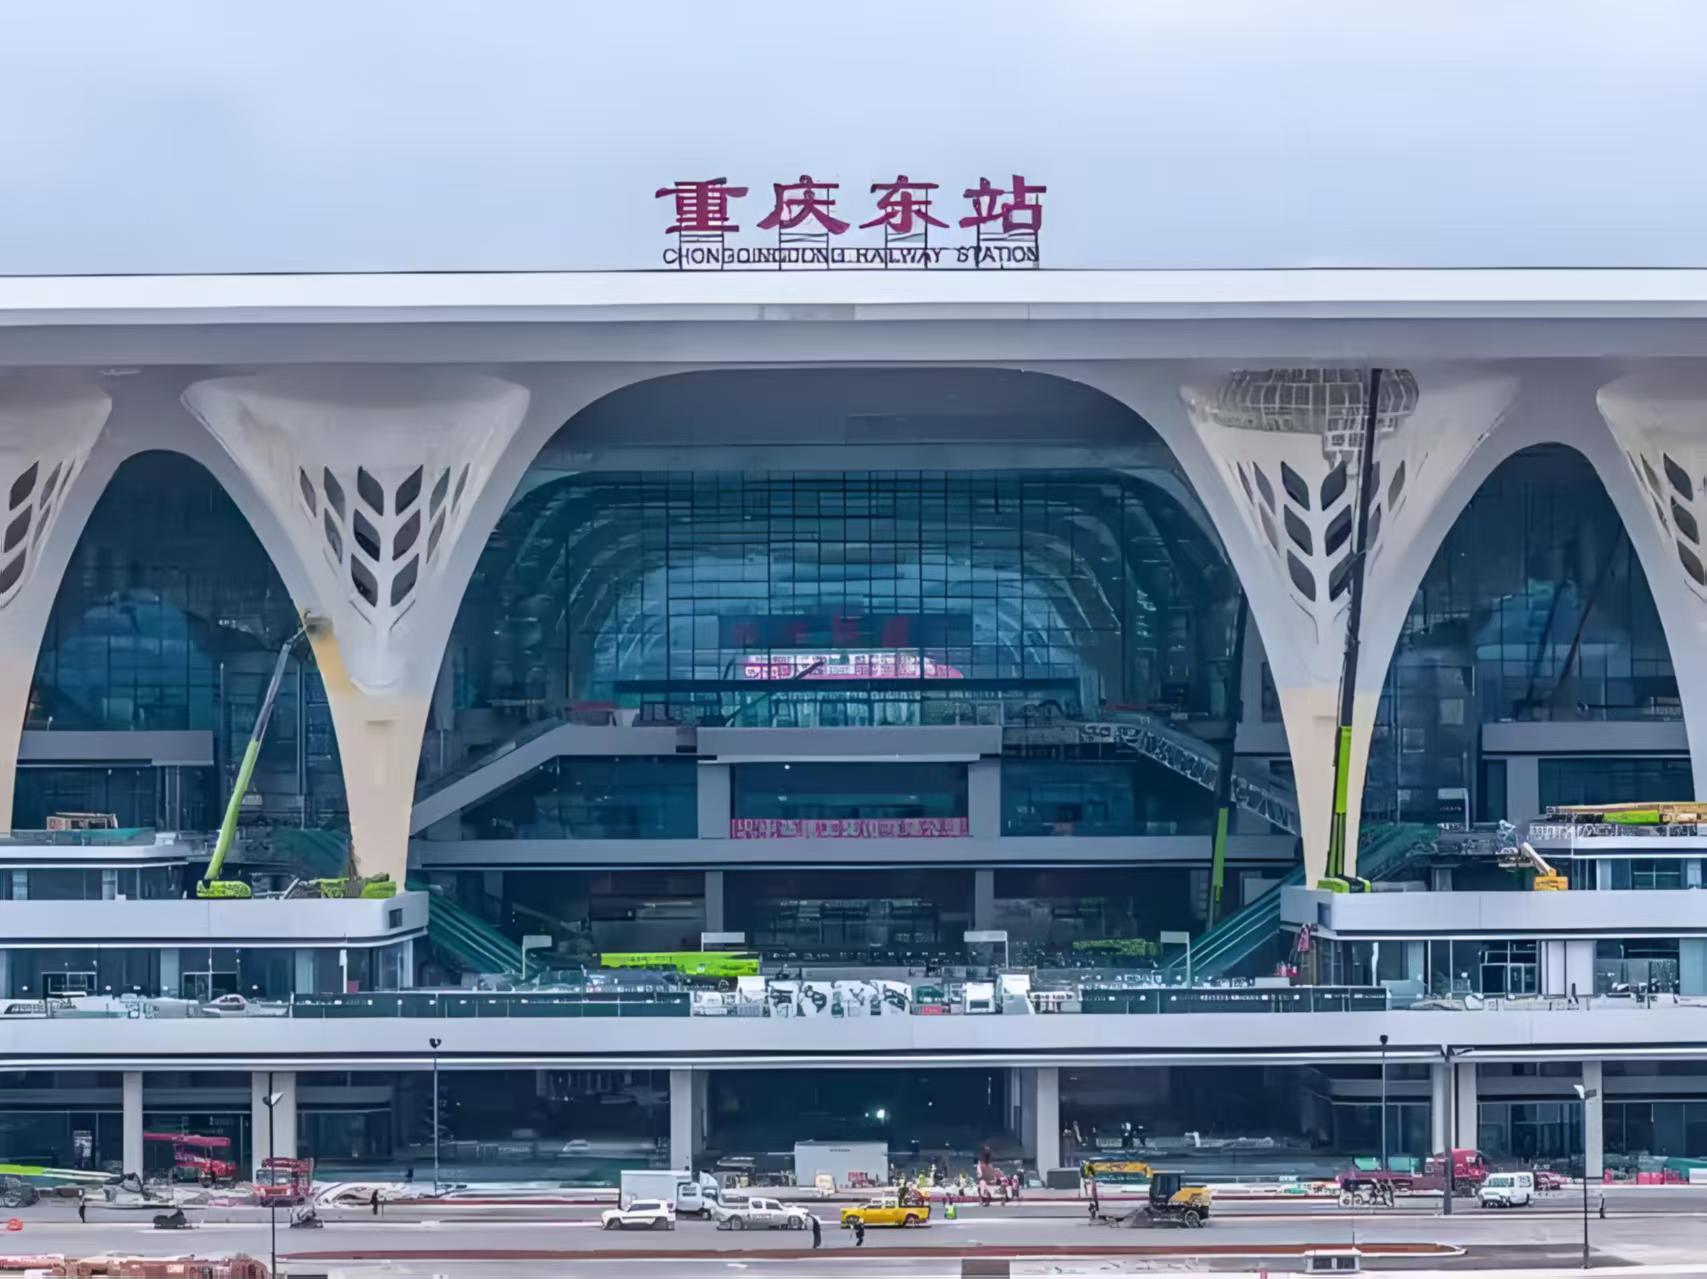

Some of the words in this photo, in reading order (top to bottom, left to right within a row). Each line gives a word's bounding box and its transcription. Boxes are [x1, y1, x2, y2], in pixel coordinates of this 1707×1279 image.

[655, 174, 1046, 235] 重庆东站
[957, 246, 1038, 263] STATION
